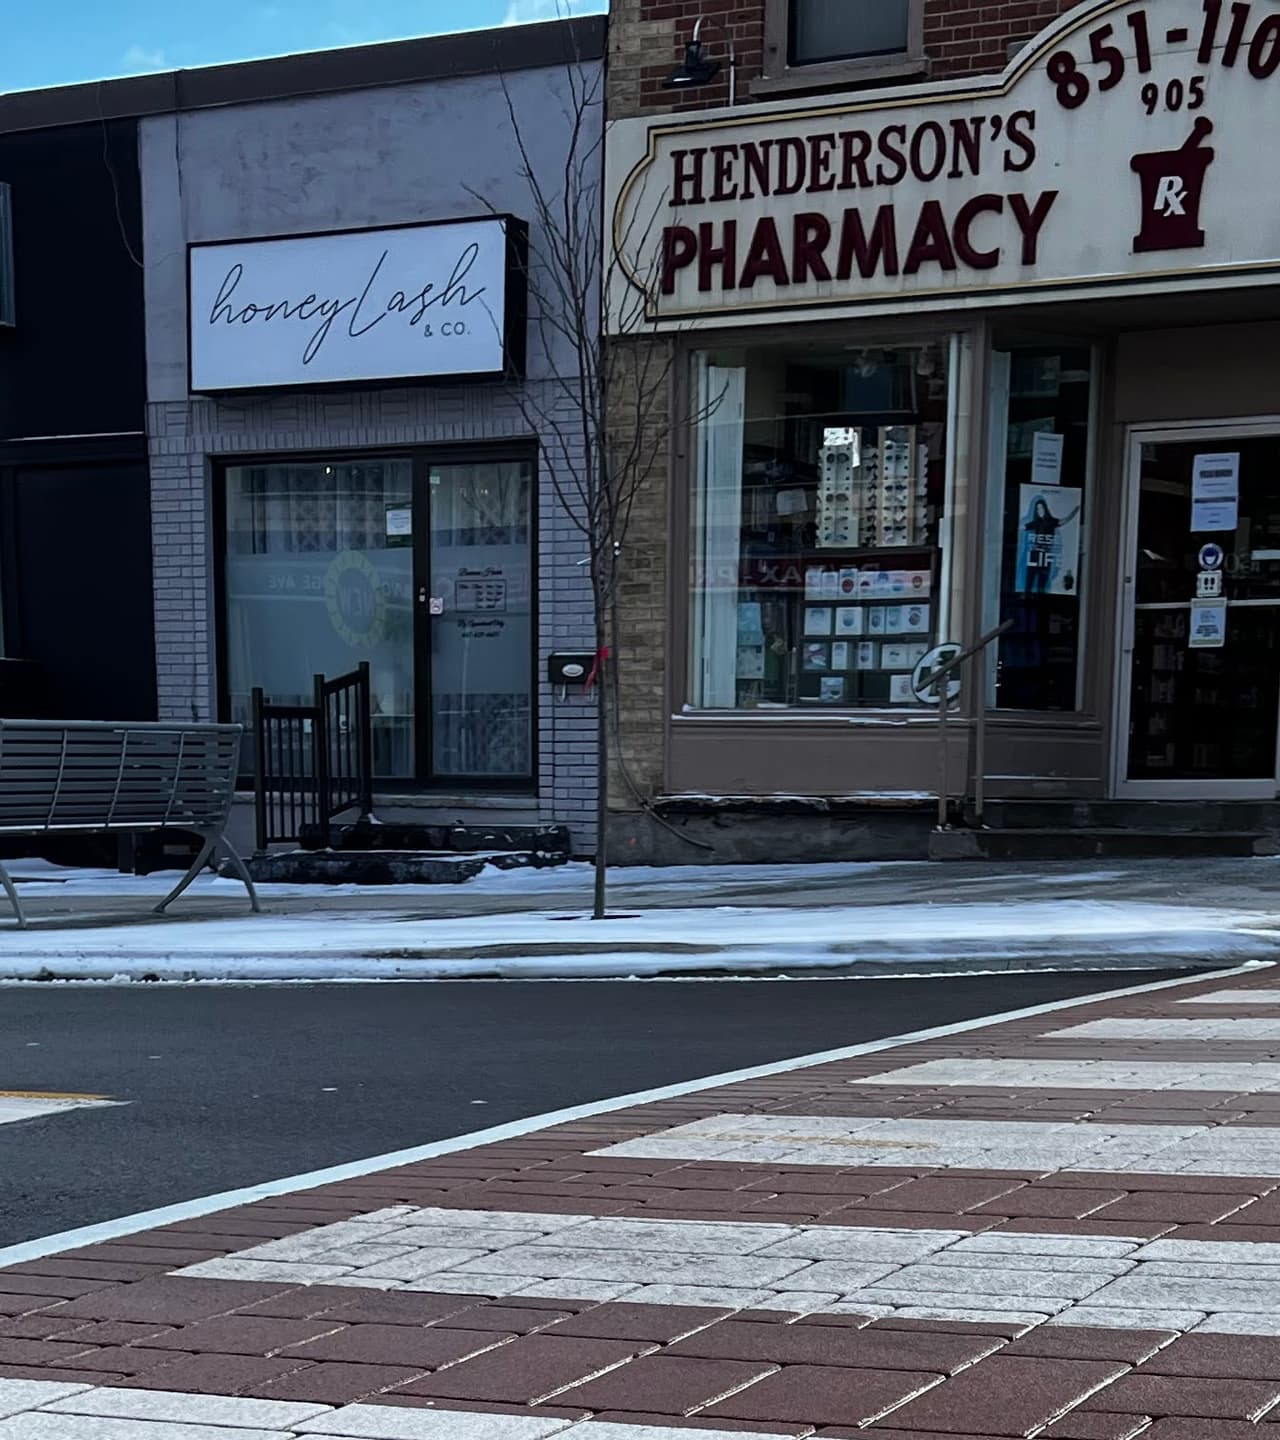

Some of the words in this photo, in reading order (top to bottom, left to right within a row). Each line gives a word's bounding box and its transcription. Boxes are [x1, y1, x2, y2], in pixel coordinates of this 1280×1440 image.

[1141, 75, 1205, 116] 905
[668, 109, 1036, 207] HENDERSON'S
[661, 190, 1059, 295] PHARMACY
[423, 324, 434, 338] &
[440, 321, 471, 337] CO.
